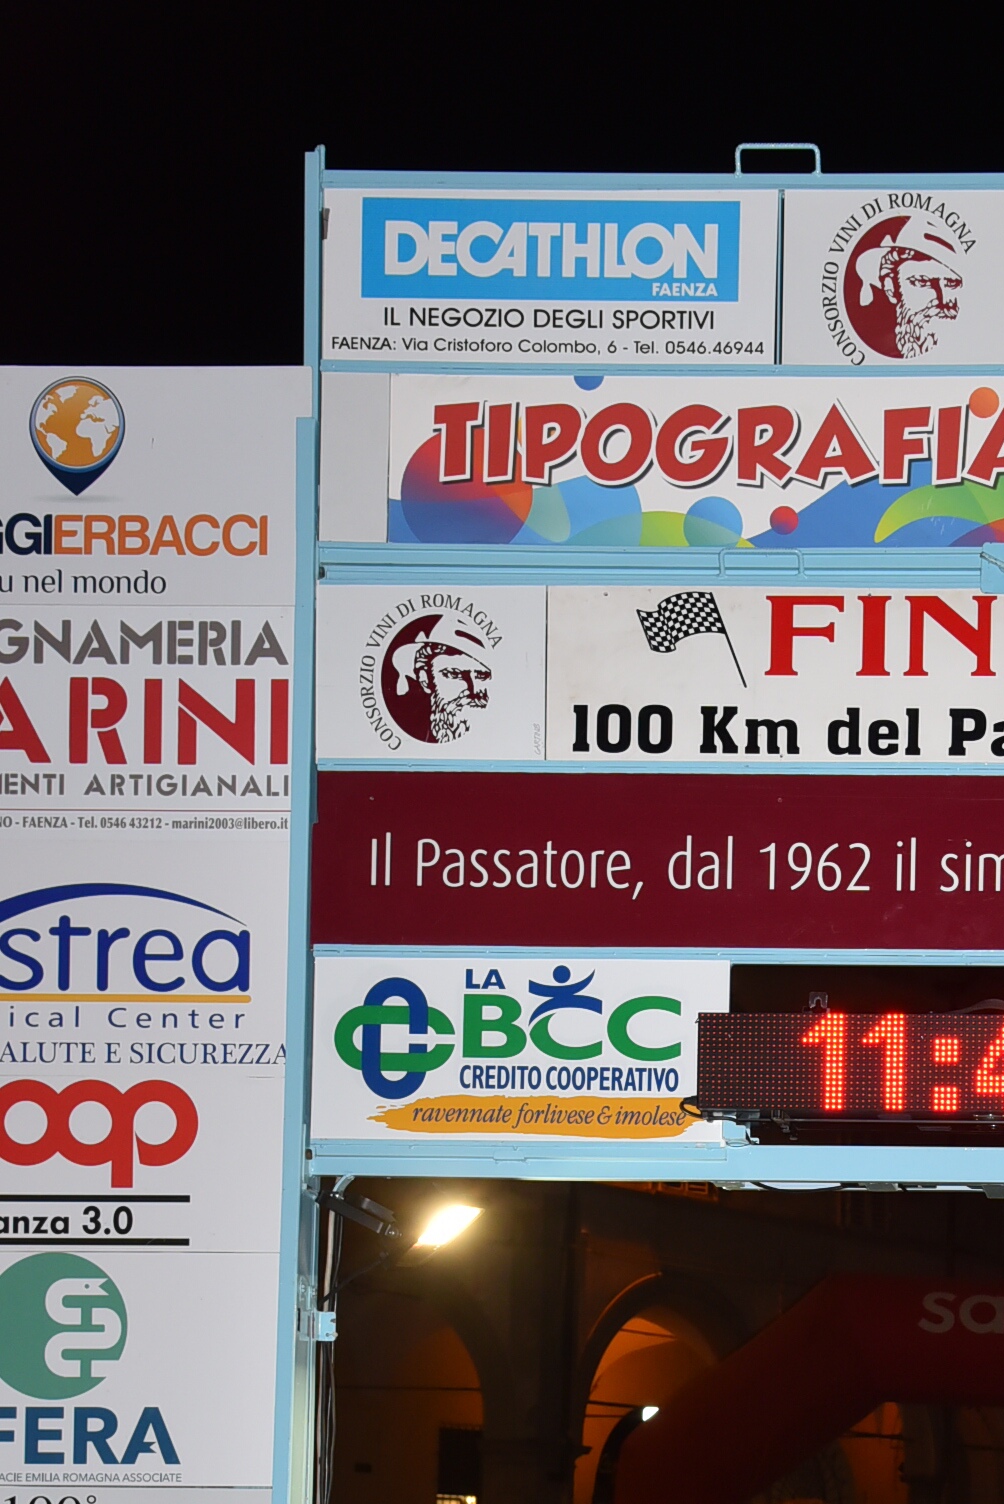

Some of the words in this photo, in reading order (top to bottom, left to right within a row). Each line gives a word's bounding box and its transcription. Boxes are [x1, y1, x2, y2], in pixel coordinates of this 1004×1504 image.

[860, 196, 886, 218] DI
[828, 211, 865, 256] VINI
[886, 191, 977, 256] ROMAGNA
[384, 219, 719, 279] DECATHLON
[651, 282, 718, 297] FAENZA
[383, 307, 402, 327] IL
[409, 307, 525, 329] NEGOZIO
[534, 308, 603, 329] DEGLI
[611, 309, 715, 330] SPORTIVI
[821, 259, 866, 365] CONSORZIO
[331, 336, 397, 352] FAENZA:
[402, 337, 429, 353] Via
[434, 337, 513, 354] Cristoforo
[517, 338, 602, 356] Colombo,
[607, 340, 617, 354] 6
[633, 340, 660, 355] Tel.
[665, 340, 764, 355] 0546.46944
[0, 512, 269, 557] GIERBACCI
[22, 569, 63, 594] nel
[71, 570, 168, 596] mondo
[396, 599, 418, 618] DI
[419, 592, 505, 650] ROMAGNA
[0, 619, 289, 667] GNAMERIA
[366, 609, 400, 650] VINI
[358, 653, 403, 751] CONSORZIO
[571, 703, 674, 754] 100
[699, 705, 800, 755] Km
[826, 706, 922, 756] del
[83, 772, 289, 798] ARTIGIANALI
[22, 816, 68, 829] FAENZA
[77, 817, 98, 829] Tel.
[100, 817, 127, 829] 0546
[129, 817, 162, 830] 43212
[171, 818, 289, 831] marini2003@libero.it
[370, 831, 393, 887] Il
[415, 838, 644, 900] Passatore,
[667, 834, 734, 890] dal
[758, 842, 871, 892] 1962
[895, 836, 917, 892] il
[0, 914, 251, 993] strea
[465, 969, 505, 990] LA
[9, 1006, 81, 1029] ical
[107, 1007, 246, 1030] Center
[462, 994, 683, 1063] BCC
[104, 1042, 121, 1063] E
[459, 1065, 542, 1091] CREDITO
[545, 1066, 680, 1093] COOPERATIVO
[411, 1104, 512, 1125] ravennate
[511, 1103, 593, 1130] forlivese
[597, 1107, 611, 1126] &
[615, 1104, 686, 1127] imolese
[82, 1206, 133, 1236] 3.0
[25, 1473, 61, 1484] EMILIA
[62, 1473, 122, 1484] ROMAGNA
[122, 1473, 183, 1484] ASSOCIATE
